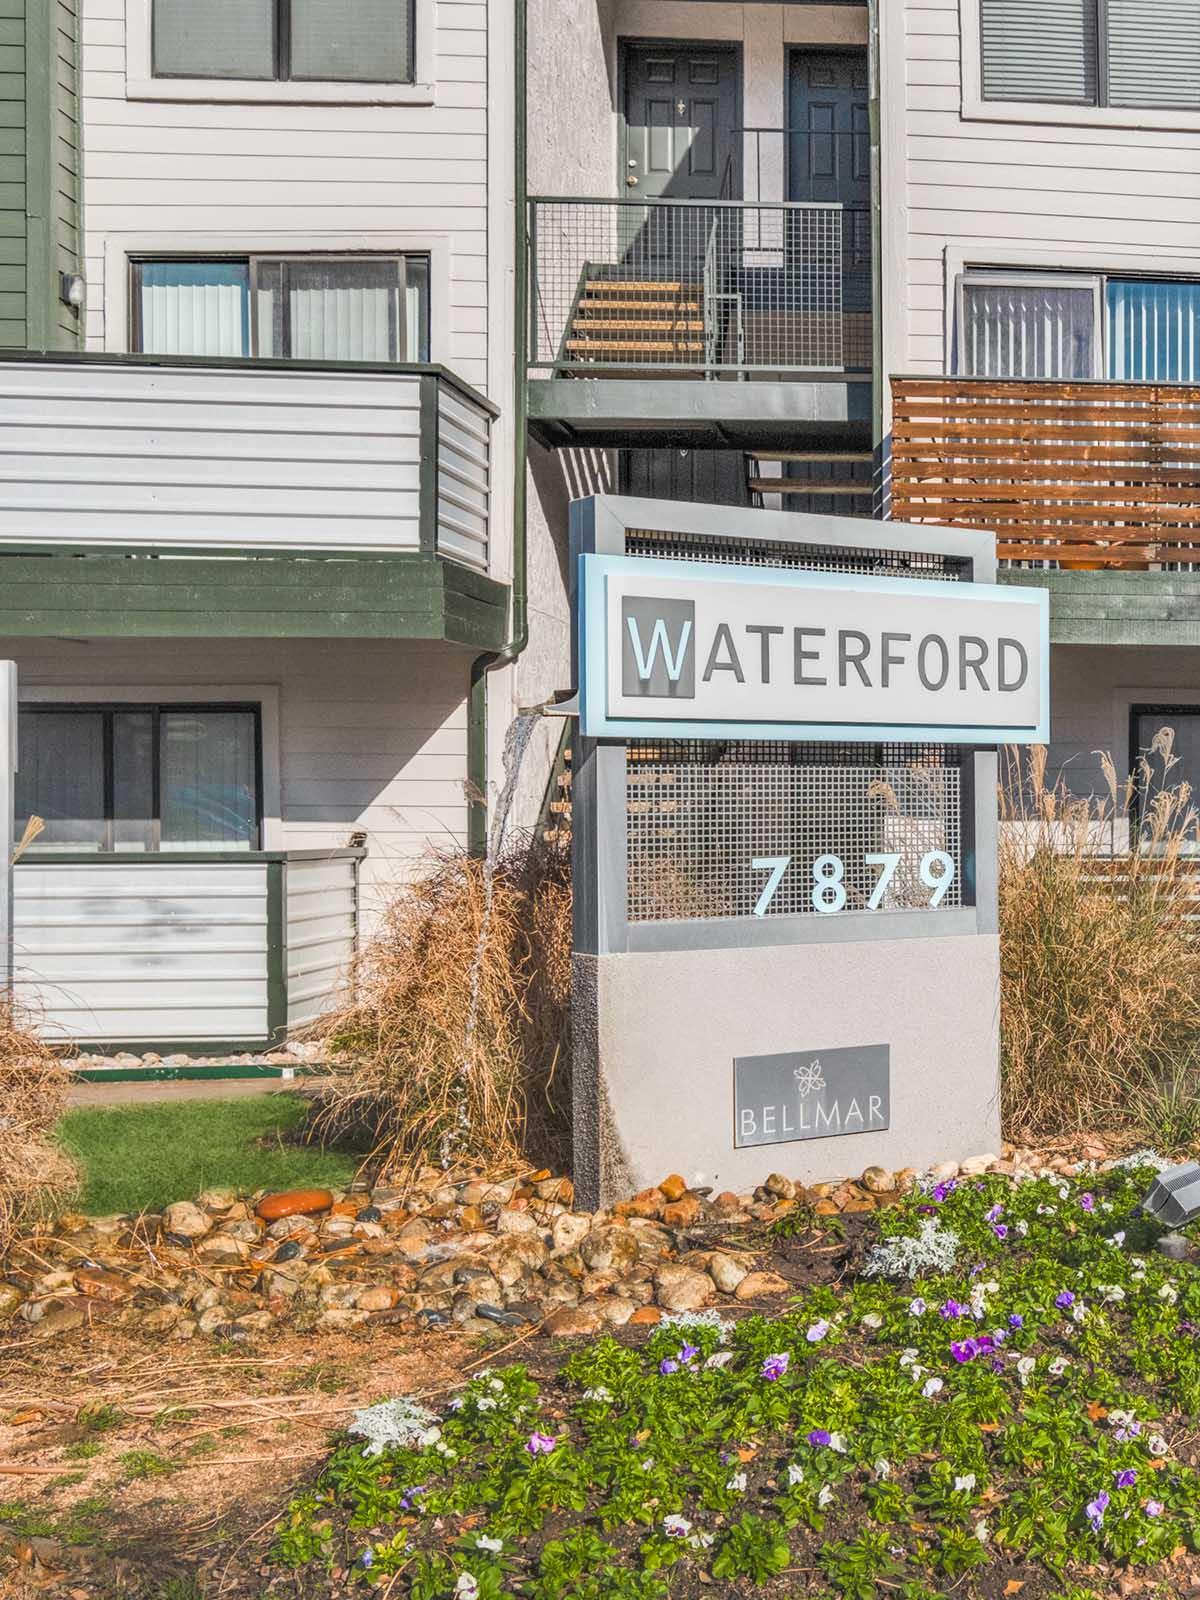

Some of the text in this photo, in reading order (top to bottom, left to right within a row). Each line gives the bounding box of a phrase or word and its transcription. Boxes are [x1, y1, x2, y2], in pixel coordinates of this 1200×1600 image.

[626, 617, 1029, 692] WATERFORD
[751, 848, 955, 917] 7879
[740, 1095, 885, 1136] BELLMAR
